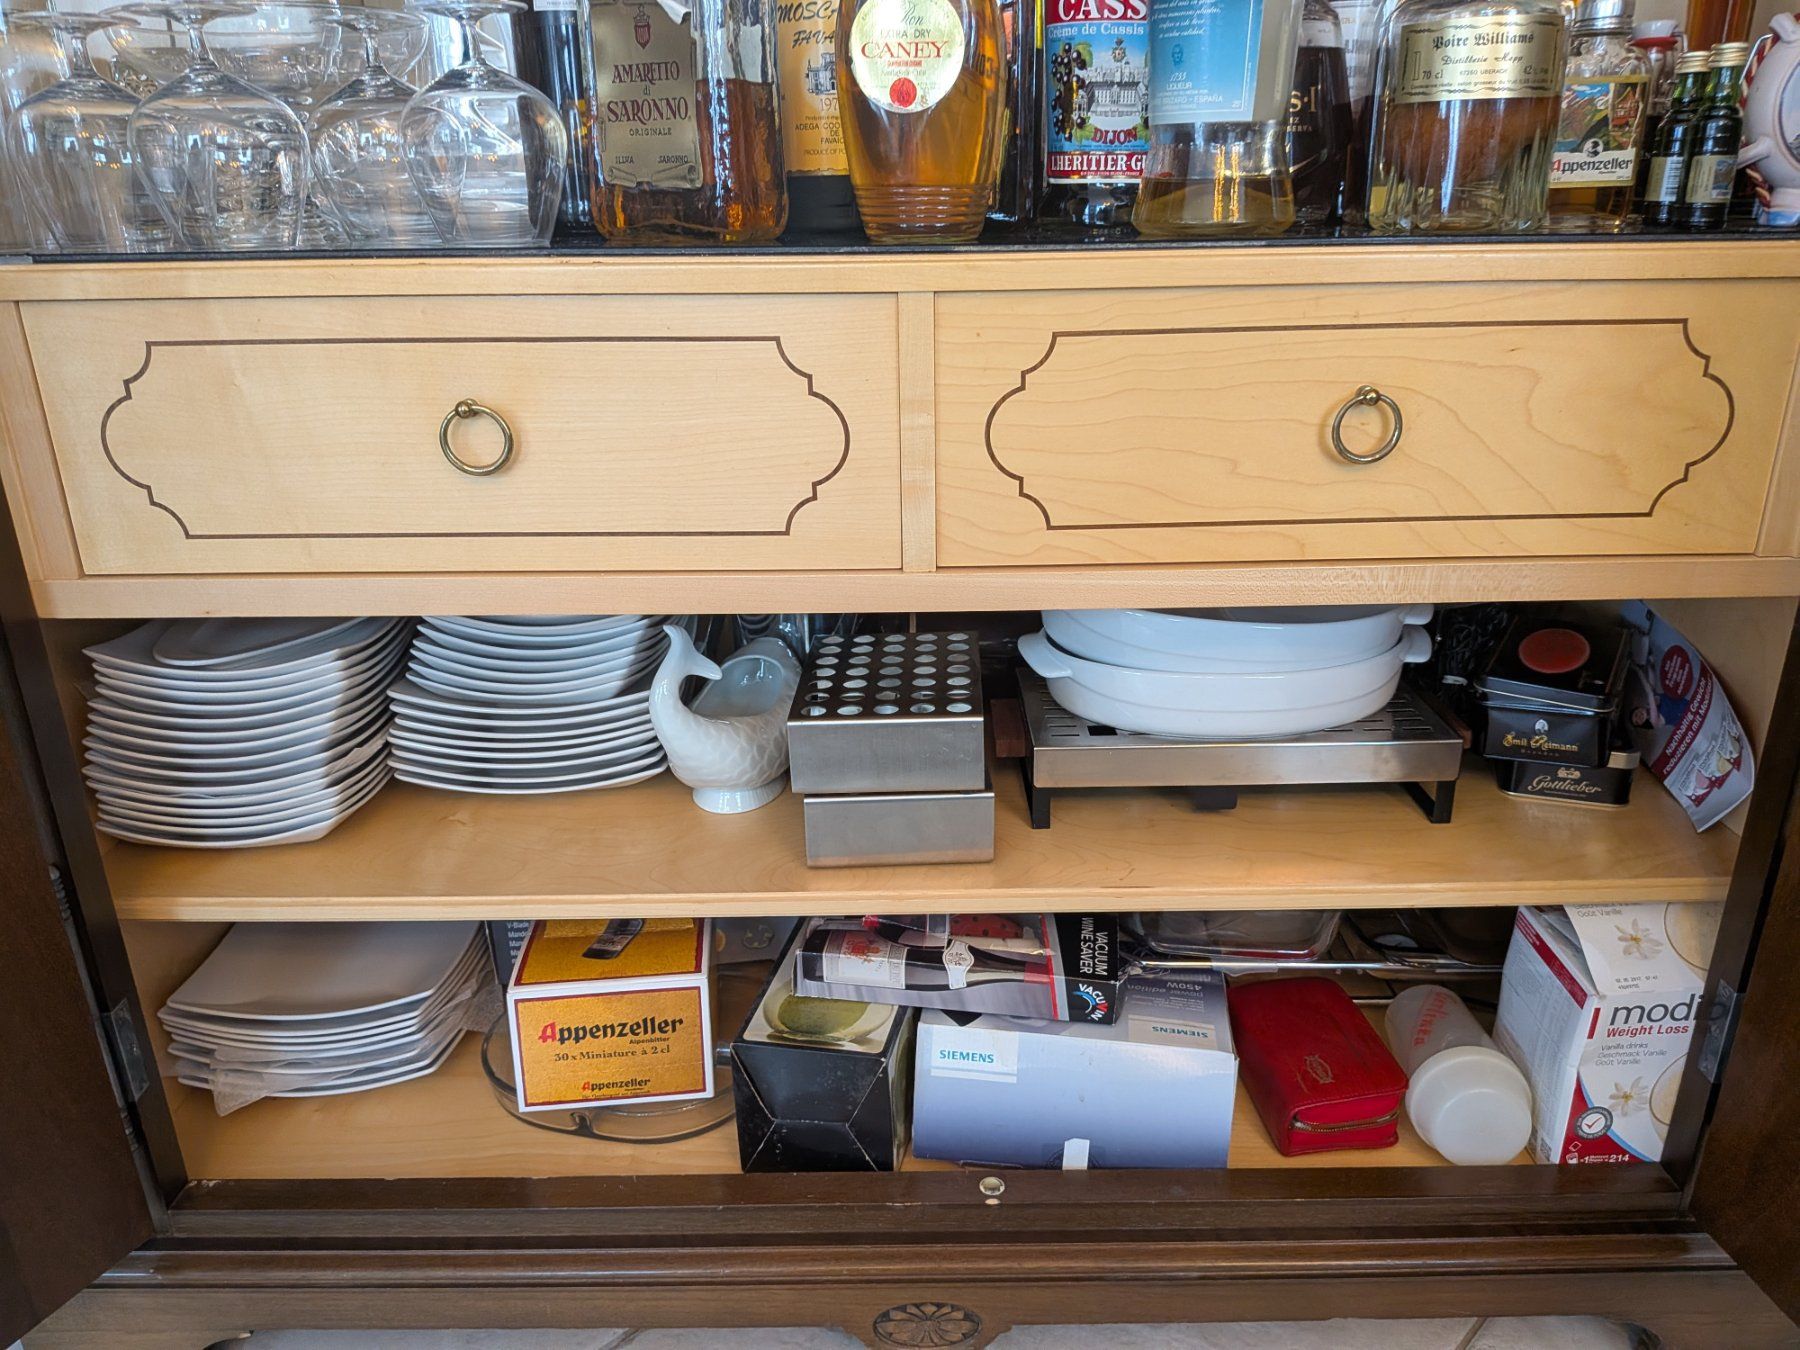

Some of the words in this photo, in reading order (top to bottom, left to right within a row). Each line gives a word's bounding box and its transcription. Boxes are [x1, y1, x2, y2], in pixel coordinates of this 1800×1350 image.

[913, 29, 931, 38] DRY
[1081, 23, 1097, 35] de
[1101, 22, 1144, 35] Cassis
[1433, 34, 1469, 51] Poire
[1474, 31, 1534, 46] Williams
[861, 40, 949, 59] CANEY
[612, 61, 680, 85] AMARETTO
[1422, 70, 1431, 80] 70
[1434, 69, 1443, 79] cl
[643, 85, 651, 95] di
[607, 96, 689, 125] SARONNO
[629, 127, 672, 136] ORIGINALE
[1092, 127, 1138, 145] DIJON
[658, 155, 688, 164] SARONNO
[1551, 157, 1633, 175] Appenzeller
[1665, 711, 1694, 756] Nachhaltig
[1503, 731, 1527, 747] Emil
[1530, 734, 1579, 752] Reimann
[1527, 775, 1602, 794] Gottlieber
[1081, 917, 1094, 939] WINE
[1079, 941, 1093, 974] SAVER
[1094, 931, 1108, 976] VACUUM
[1127, 984, 1166, 994] edition
[1167, 981, 1203, 991] 450W
[538, 1016, 684, 1045] Appenzeller
[1151, 1026, 1209, 1039] SIEMENS
[1606, 1024, 1655, 1038] Weight
[1656, 1024, 1689, 1035] Loss
[629, 1036, 670, 1045] Alpenbitter
[1601, 1043, 1624, 1051] Vanilla
[554, 1052, 569, 1062] 30
[579, 1049, 637, 1060] Miniature
[641, 1047, 648, 1056] à
[651, 1046, 659, 1055] 2
[660, 1044, 670, 1053] cl
[939, 1049, 994, 1064] SIEMENS
[1597, 1050, 1640, 1058] Geschmack
[581, 1078, 651, 1092] Appenzeller
[1609, 1154, 1630, 1163] 214
